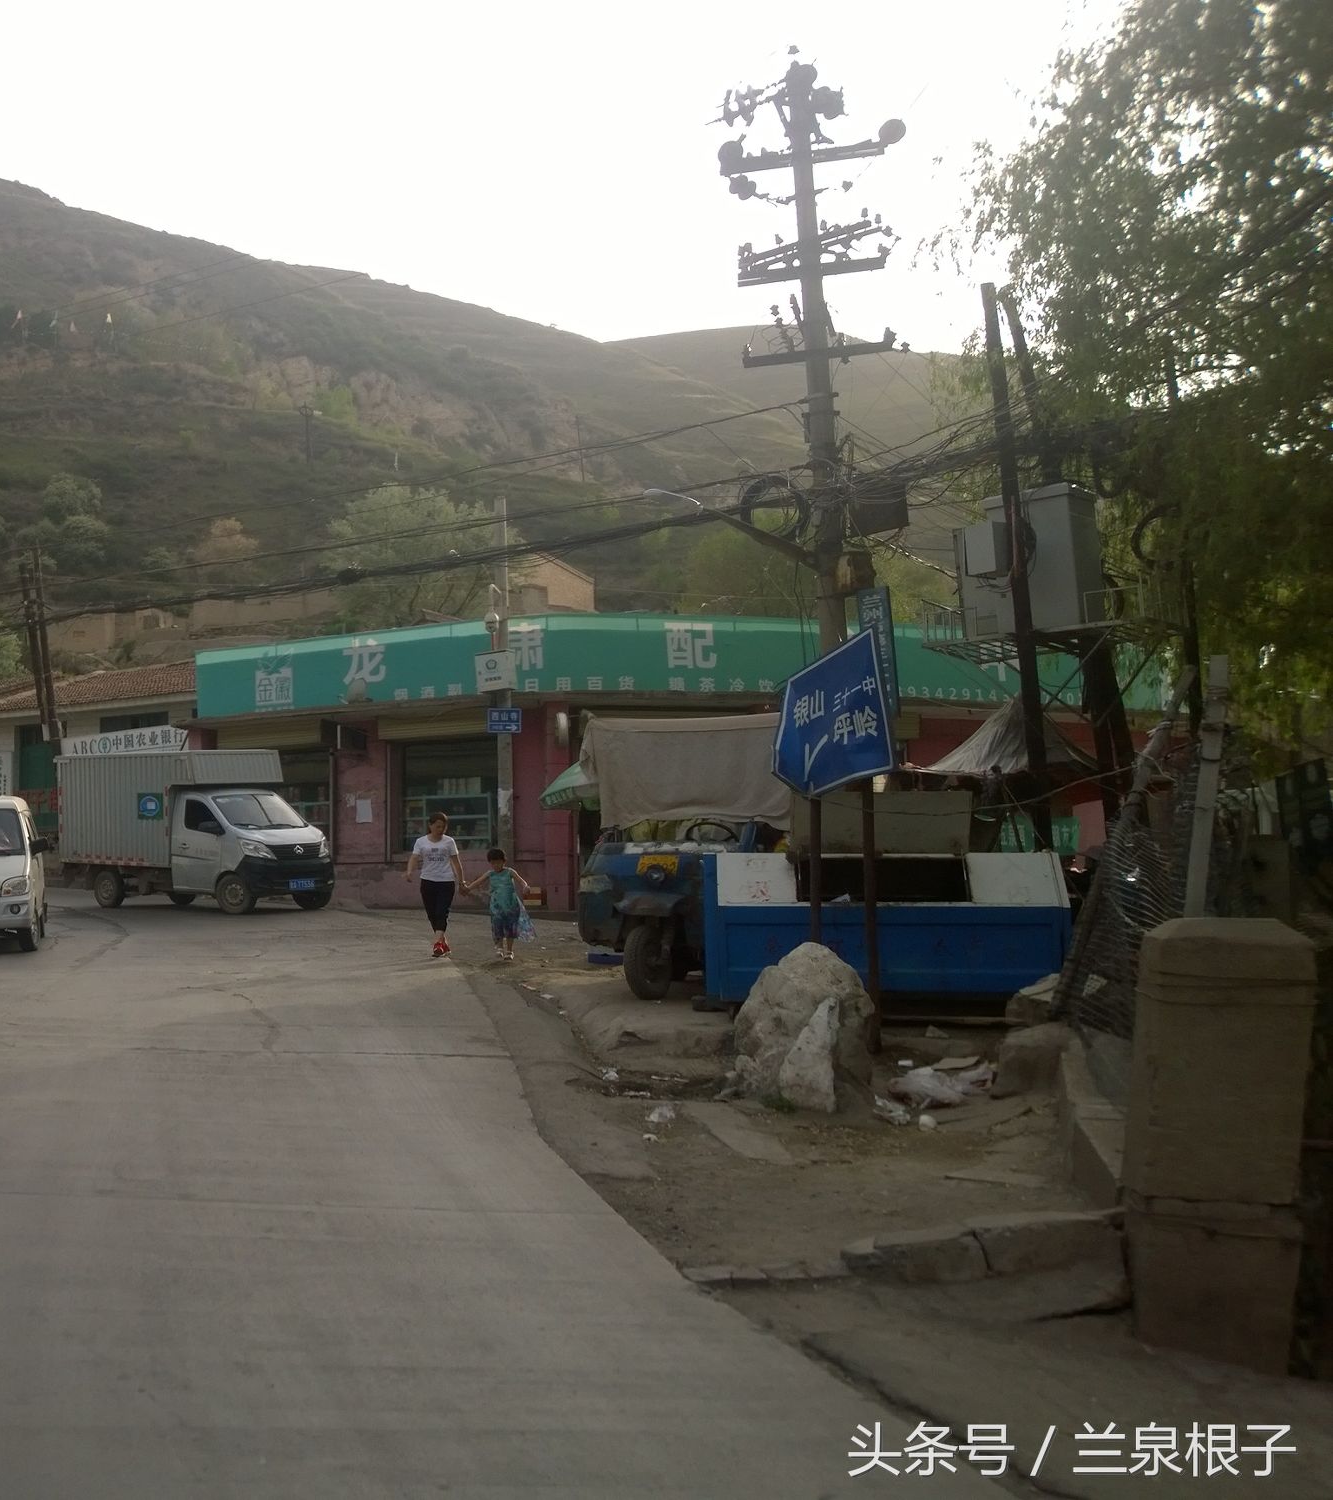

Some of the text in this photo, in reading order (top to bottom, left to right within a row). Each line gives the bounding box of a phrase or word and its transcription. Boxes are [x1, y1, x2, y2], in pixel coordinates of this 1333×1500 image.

[524, 676, 635, 692] 日用百货
[833, 676, 876, 712] 三十一中
[793, 689, 825, 728] 银山
[72, 729, 184, 755] ABC 中国农业银行
